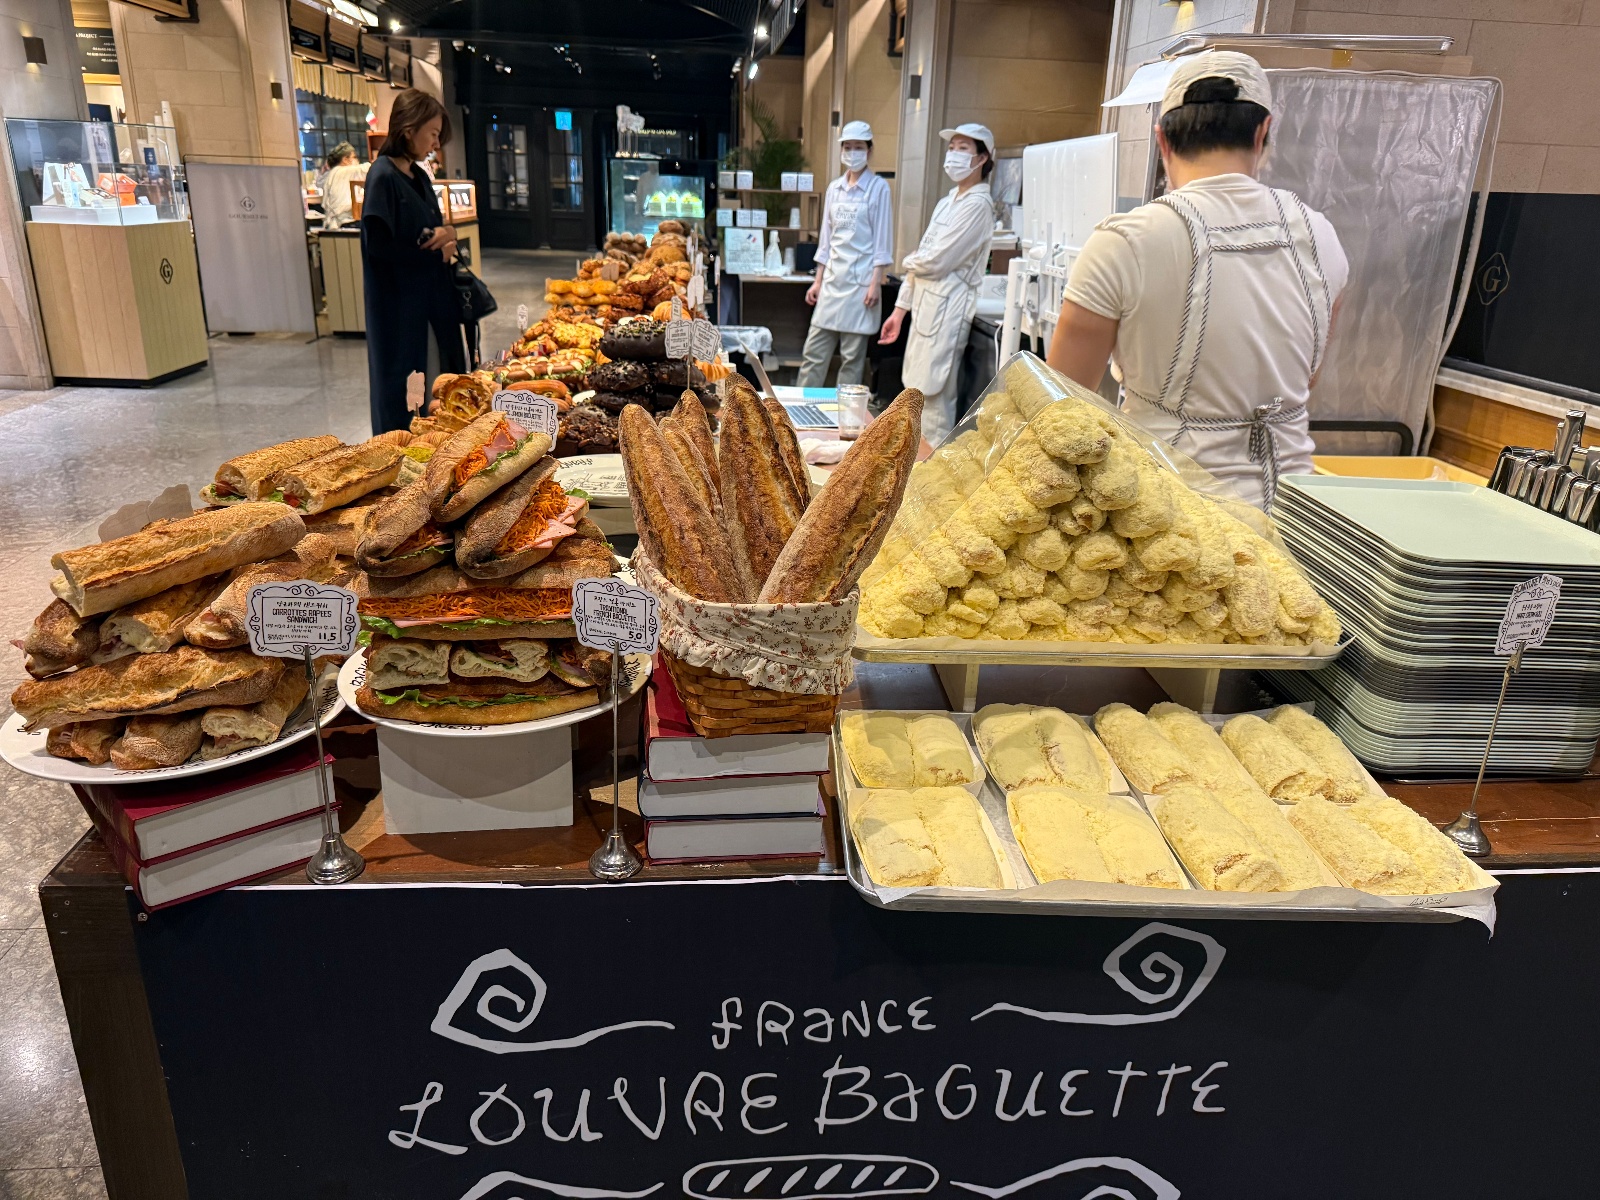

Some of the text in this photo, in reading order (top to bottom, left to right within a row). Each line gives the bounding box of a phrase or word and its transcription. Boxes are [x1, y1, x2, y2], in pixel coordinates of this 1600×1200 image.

[163, 265, 170, 278] G
[1483, 266, 1501, 292] G
[287, 616, 317, 624] SANDWICH
[593, 610, 637, 623] FRENCH BAGUETTE
[319, 633, 337, 641] 11.5
[629, 631, 642, 640] 5.0
[711, 996, 937, 1050] FRANCE
[388, 1055, 1229, 1154] LOUVRE BAGUETTE
